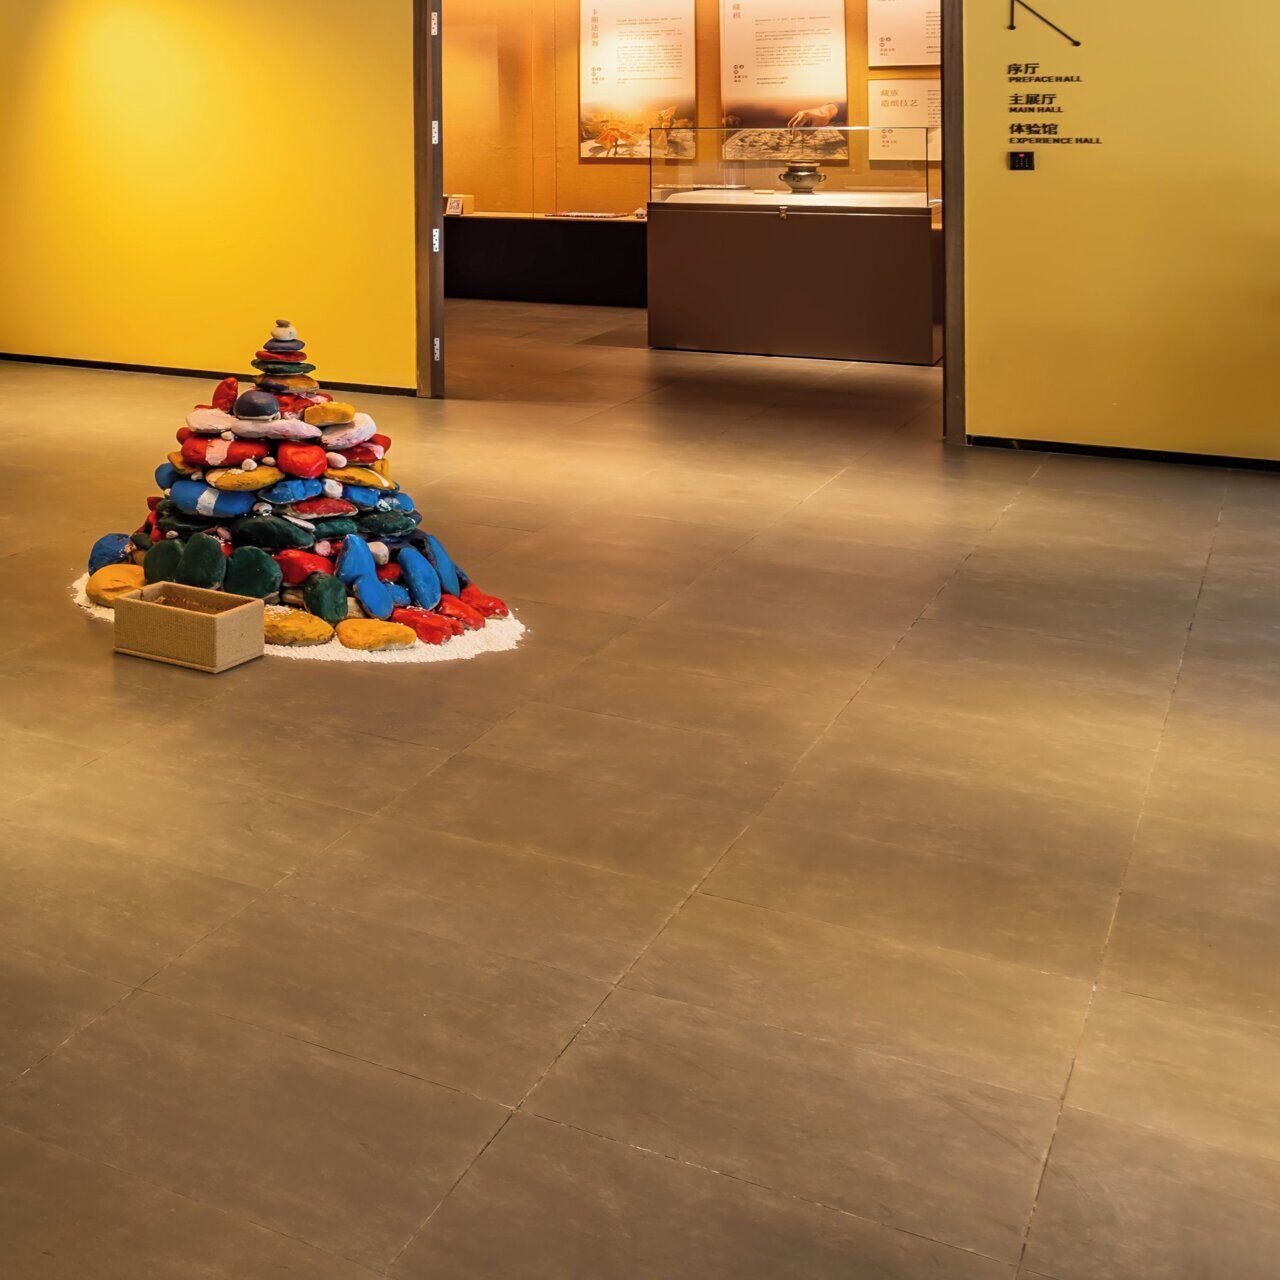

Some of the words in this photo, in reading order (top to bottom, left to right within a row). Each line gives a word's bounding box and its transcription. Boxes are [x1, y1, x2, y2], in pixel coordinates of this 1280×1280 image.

[1007, 63, 1040, 75] 序厅
[1055, 75, 1083, 83] HALL
[1008, 93, 1057, 105] 主展厅
[1009, 123, 1059, 135] 体验馆
